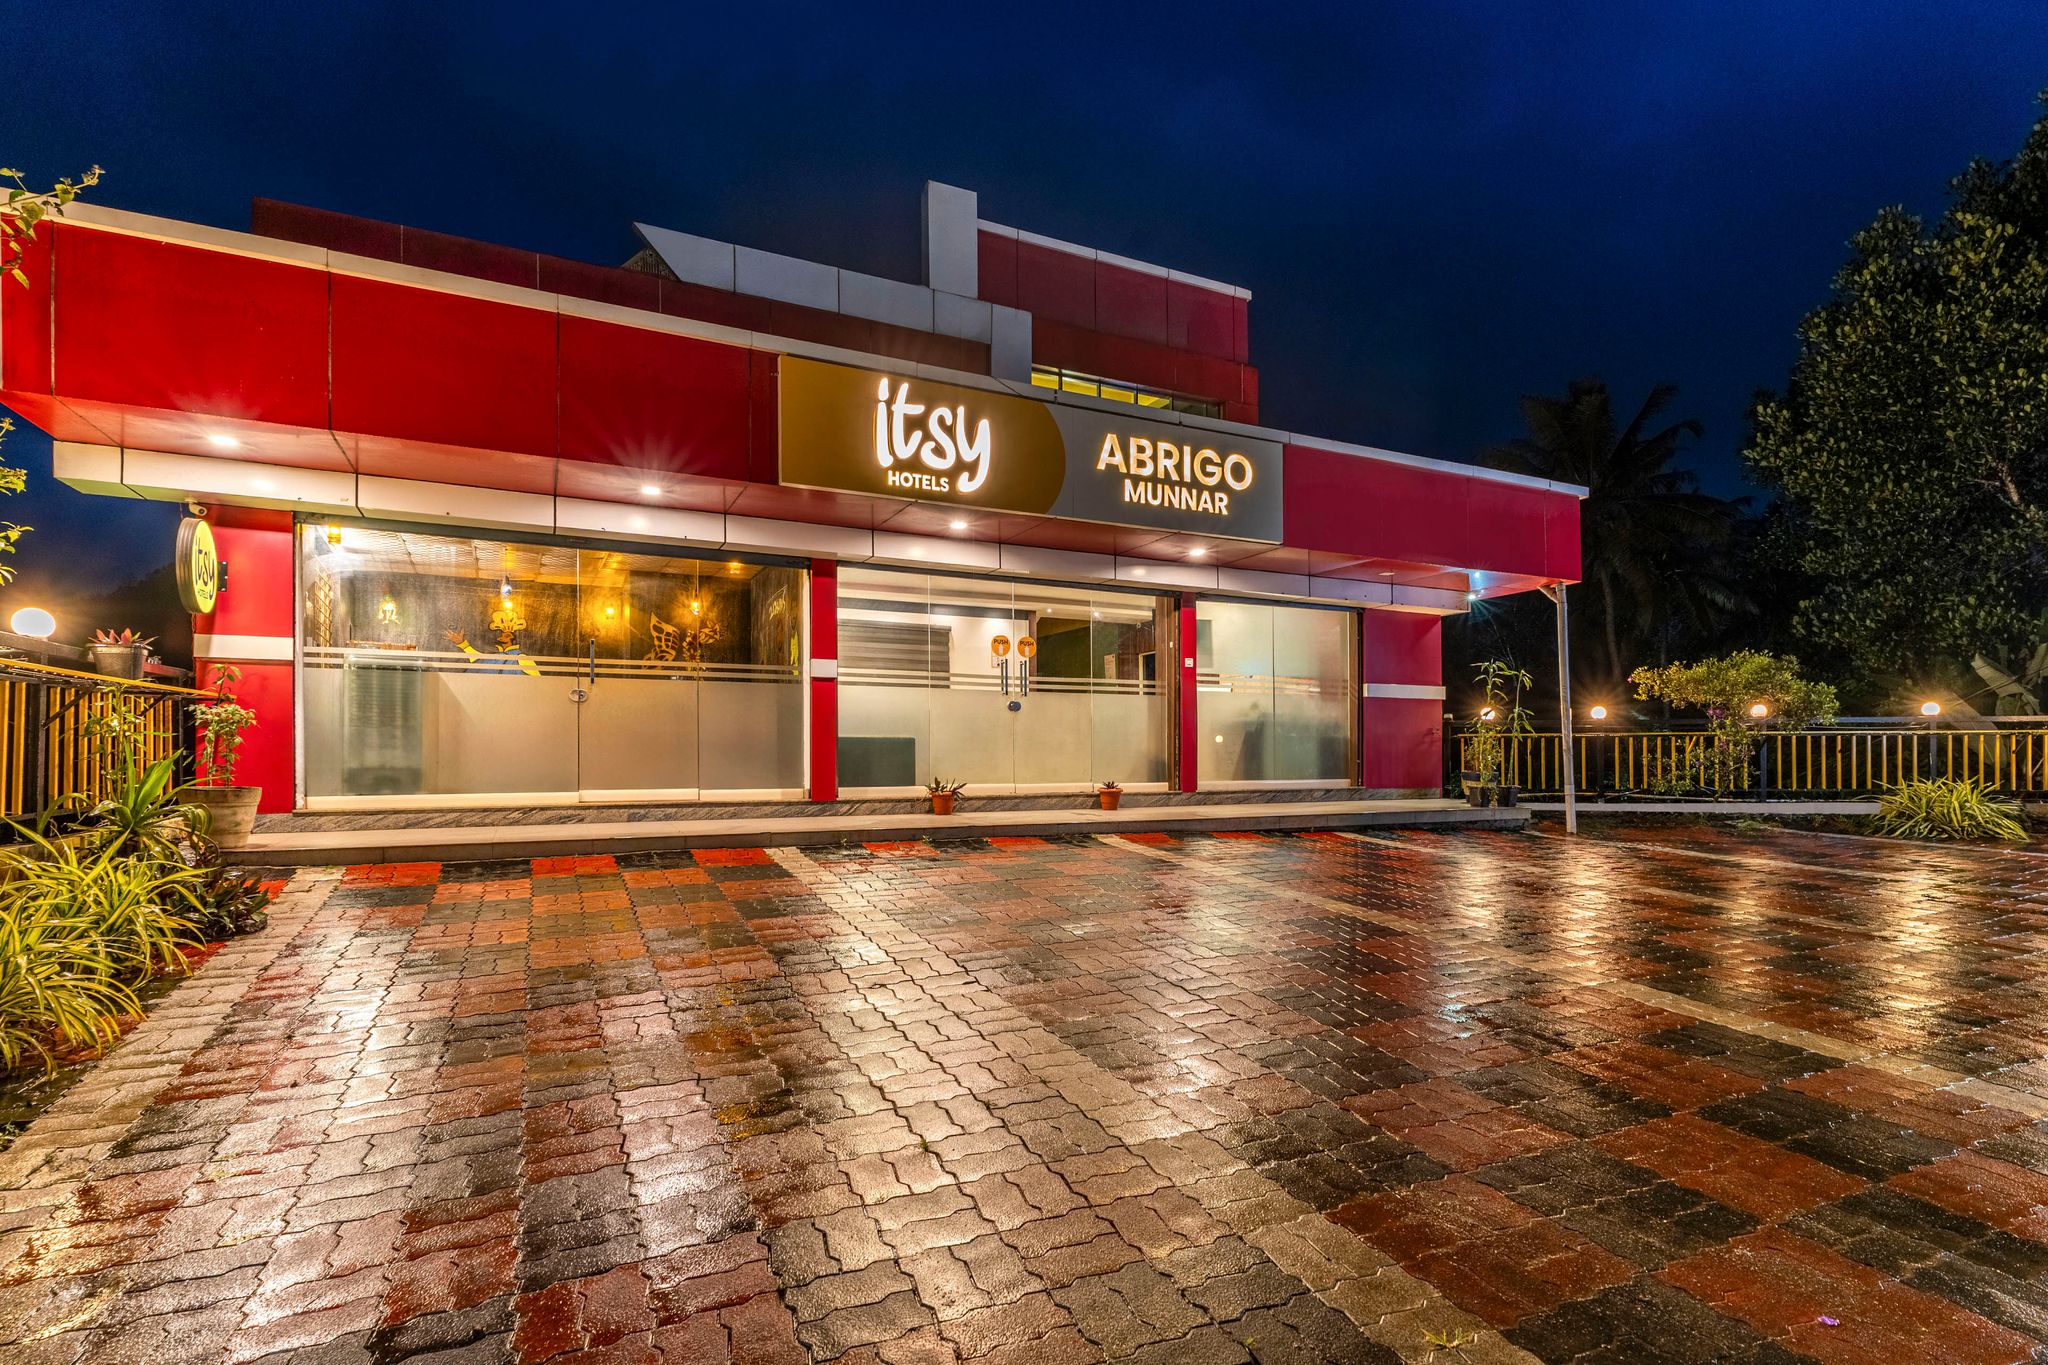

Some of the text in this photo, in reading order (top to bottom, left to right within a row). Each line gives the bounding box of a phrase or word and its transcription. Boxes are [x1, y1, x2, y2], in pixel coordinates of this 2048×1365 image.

[876, 378, 991, 492] itsy
[1096, 433, 1253, 491] ABRIGO
[887, 470, 950, 492] HOTELS
[1123, 478, 1228, 515] MUNNAR
[194, 536, 215, 601] itsy
